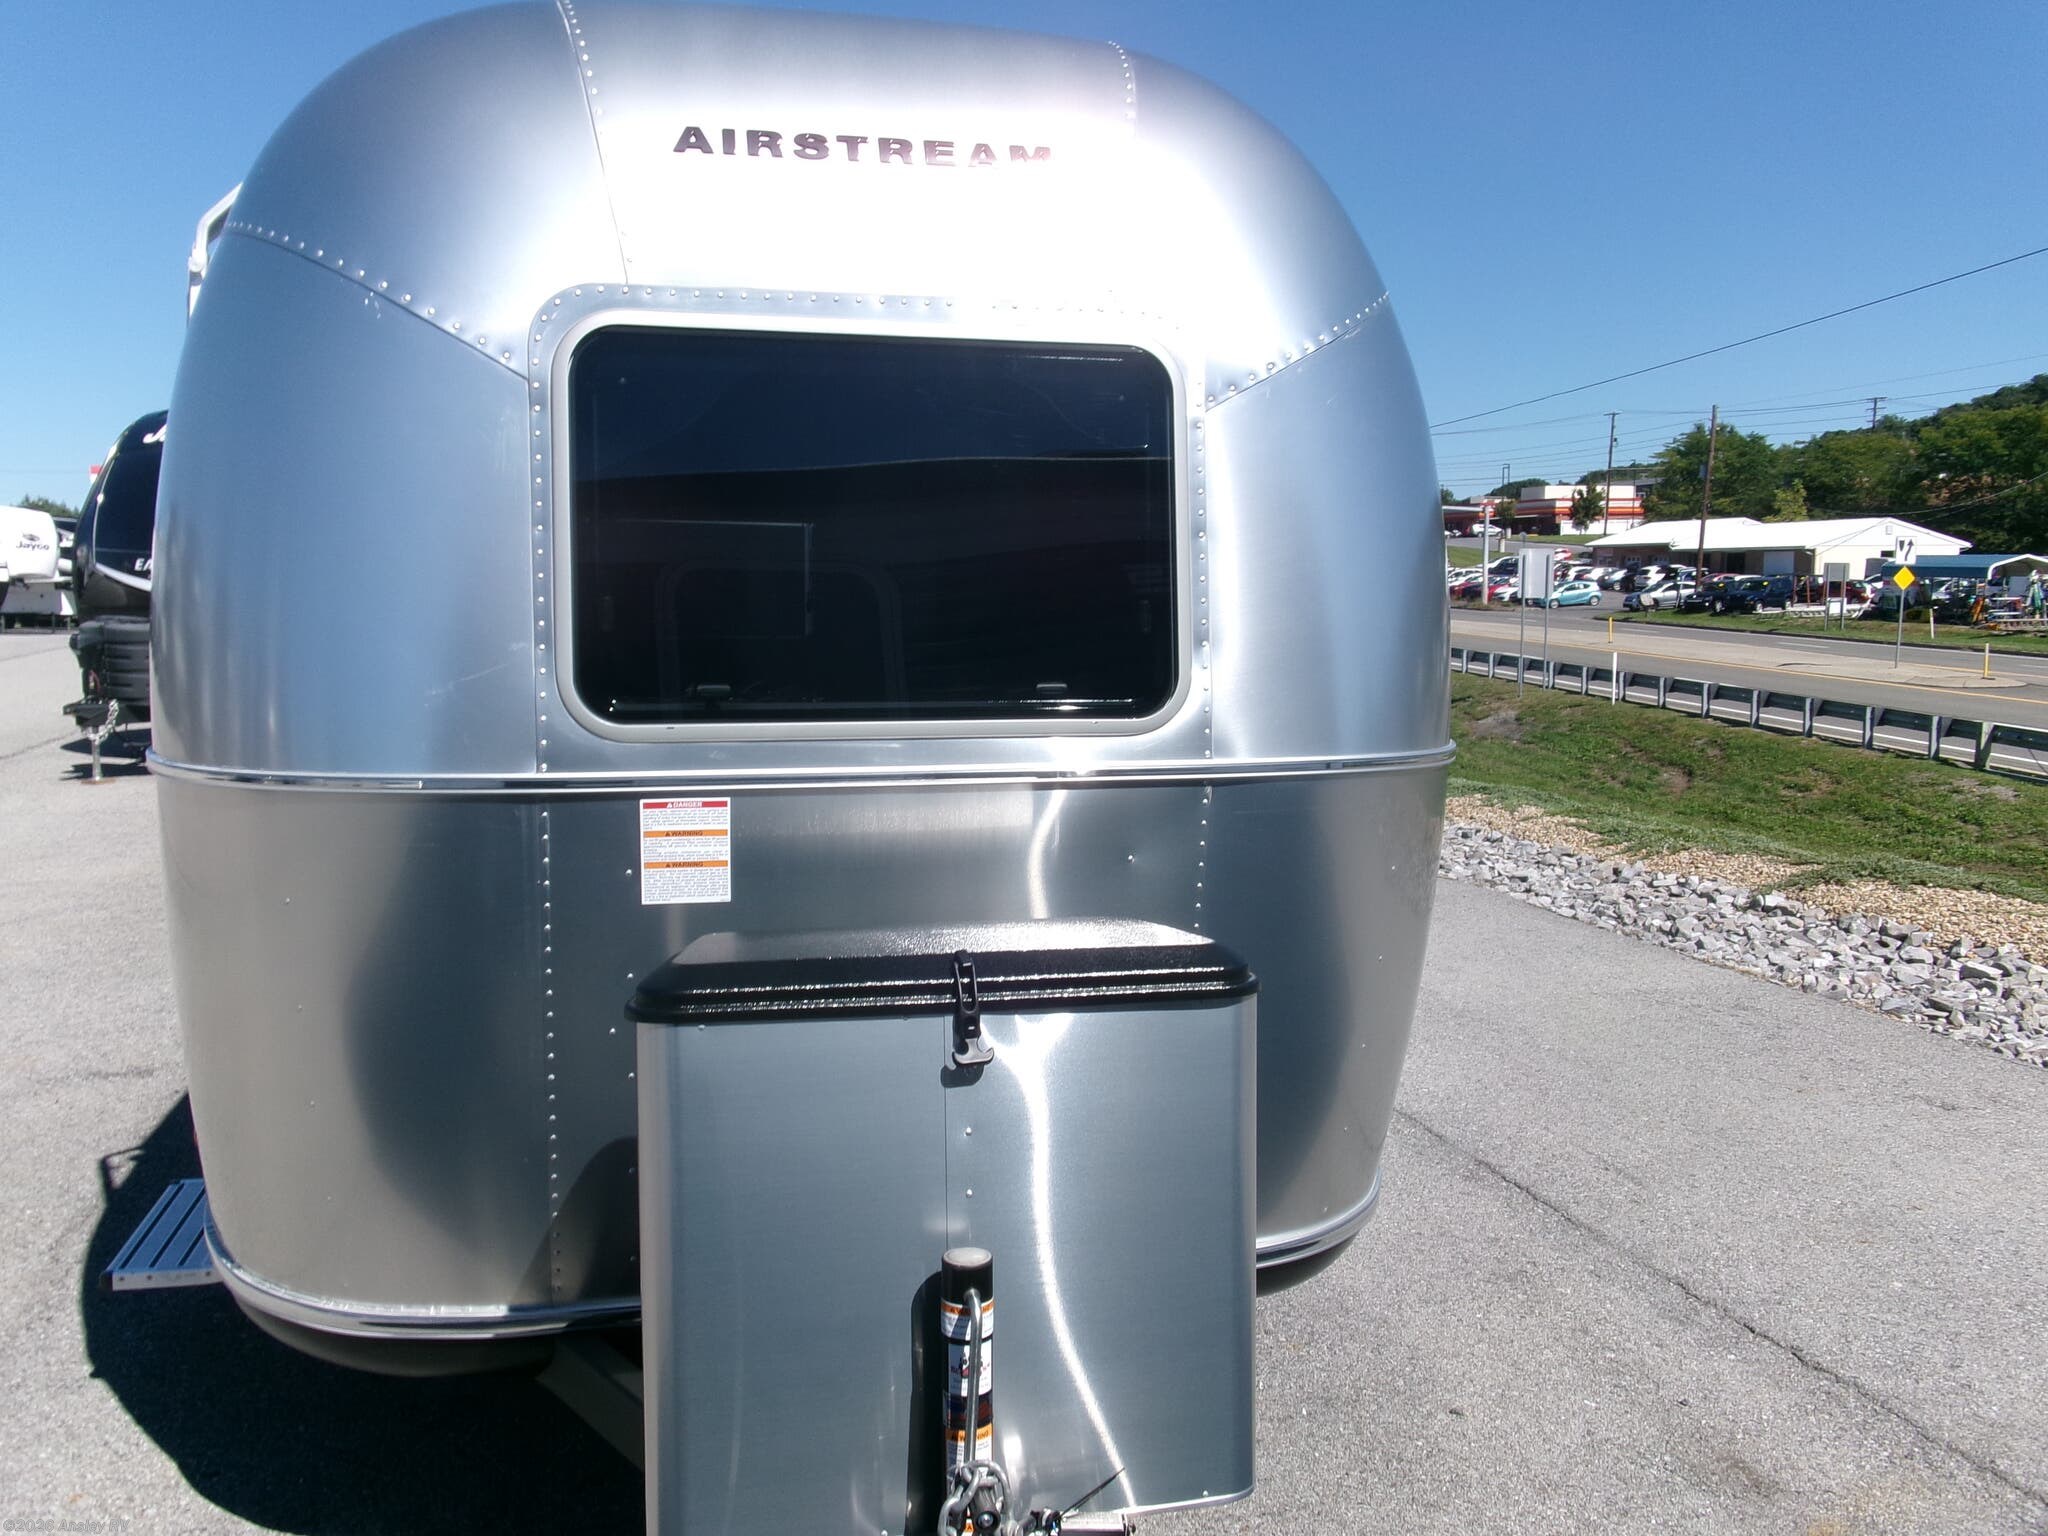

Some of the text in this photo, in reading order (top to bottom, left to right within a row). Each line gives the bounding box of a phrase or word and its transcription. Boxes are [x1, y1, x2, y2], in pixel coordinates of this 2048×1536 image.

[672, 125, 1051, 167] AIRSTREAM
[16, 541, 50, 551] Jayco
[673, 800, 703, 809] DANGER
